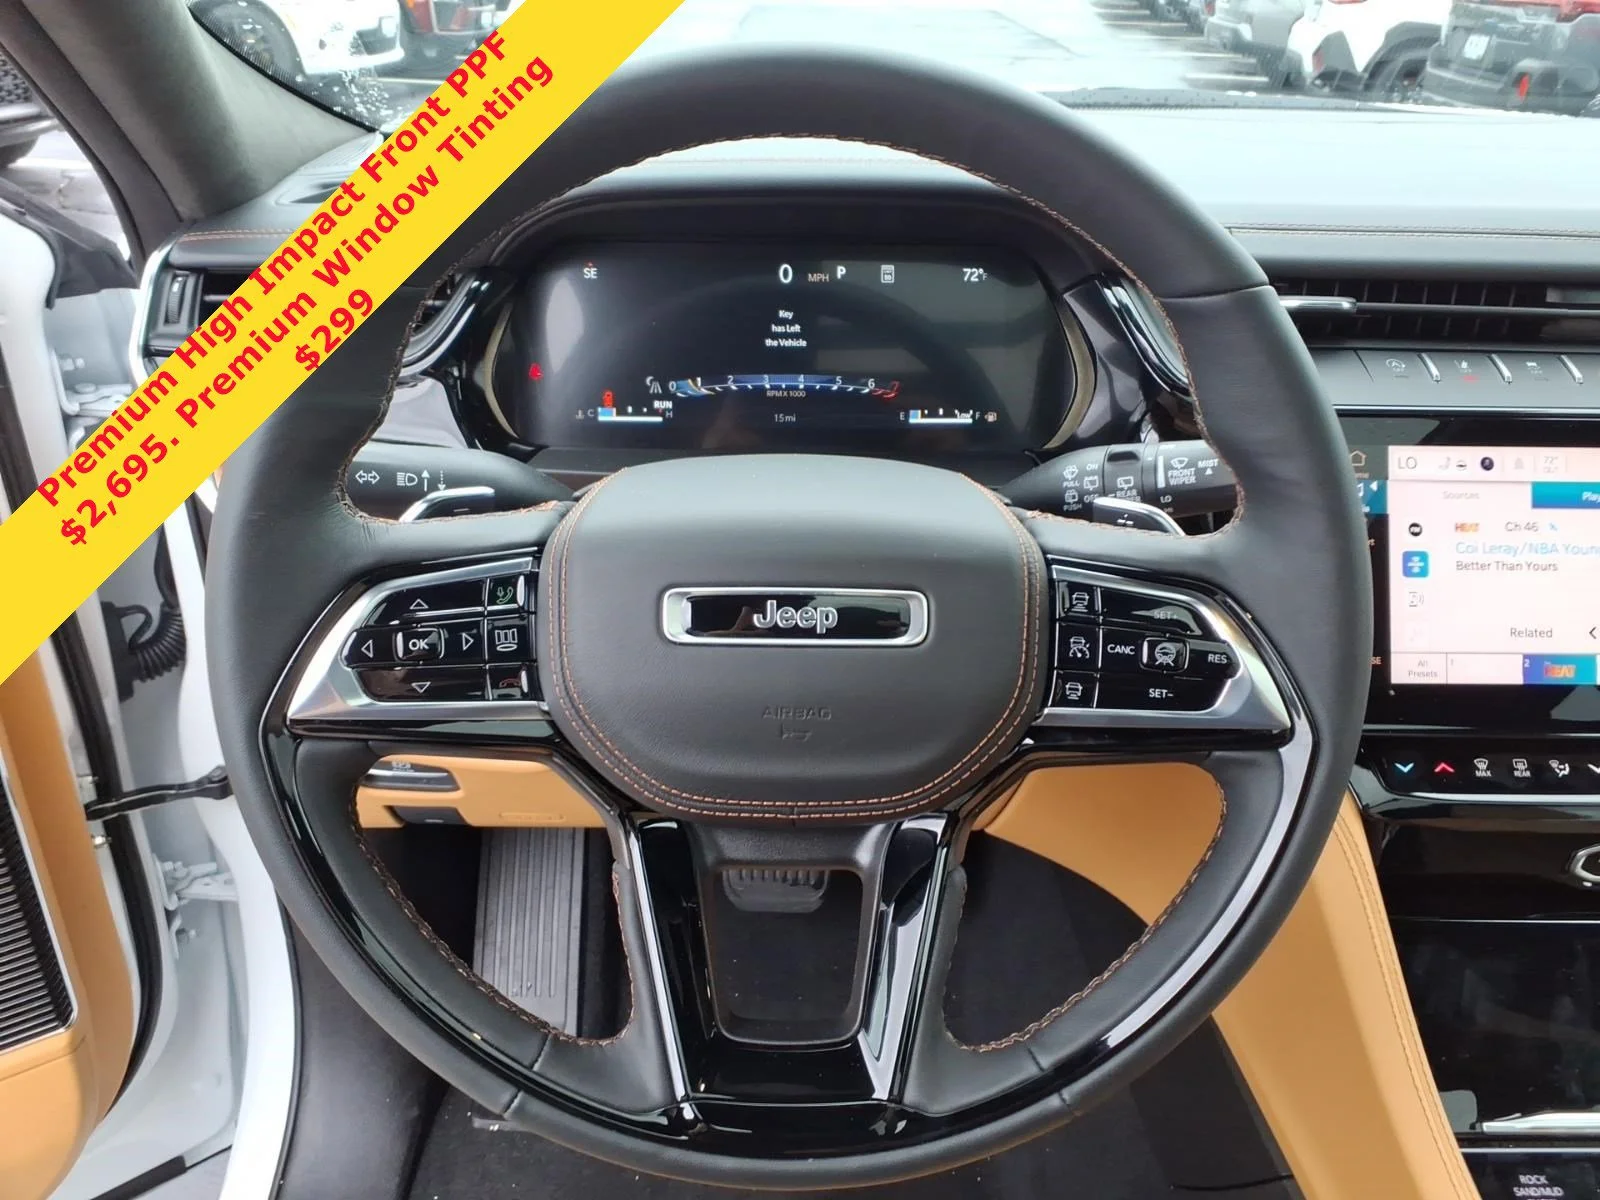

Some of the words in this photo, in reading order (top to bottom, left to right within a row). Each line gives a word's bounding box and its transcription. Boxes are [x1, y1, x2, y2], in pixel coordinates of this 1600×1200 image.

[583, 267, 598, 279] SE
[778, 263, 793, 284] 0
[807, 273, 830, 283] MPH
[837, 266, 846, 279] P
[778, 309, 794, 320] Key
[771, 324, 786, 333] has
[786, 323, 801, 333] Left
[765, 338, 778, 347] the
[778, 338, 808, 348] Vehicle
[835, 375, 843, 386] 5
[867, 378, 876, 389] 6
[653, 400, 673, 410] RUN
[665, 410, 673, 418] H
[900, 411, 905, 420] E
[975, 411, 980, 420] F
[1197, 458, 1219, 468] MIST
[1397, 456, 1418, 470] LO
[1167, 467, 1196, 478] FRONT
[1169, 476, 1197, 486] WIPER
[1116, 489, 1138, 498] REAR
[1160, 495, 1172, 503] LO
[1443, 490, 1480, 500] Sources
[1504, 521, 1522, 532] Ch
[1523, 521, 1539, 532] 46
[1455, 542, 1479, 555] Coi
[1455, 560, 1491, 571] Better
[1495, 560, 1523, 571] Than
[1525, 560, 1559, 571] Yours
[753, 600, 838, 634] Jeep
[1153, 610, 1178, 620] SET+
[1510, 627, 1553, 638] Related
[408, 638, 429, 651] OK
[1107, 643, 1136, 655] CANC
[1208, 653, 1228, 664] RES
[1523, 658, 1531, 668] 2
[1408, 670, 1438, 678] Presets
[762, 706, 832, 722] AIRBAG
[1475, 770, 1491, 778] MAX
[1519, 1174, 1548, 1185] ROCK
